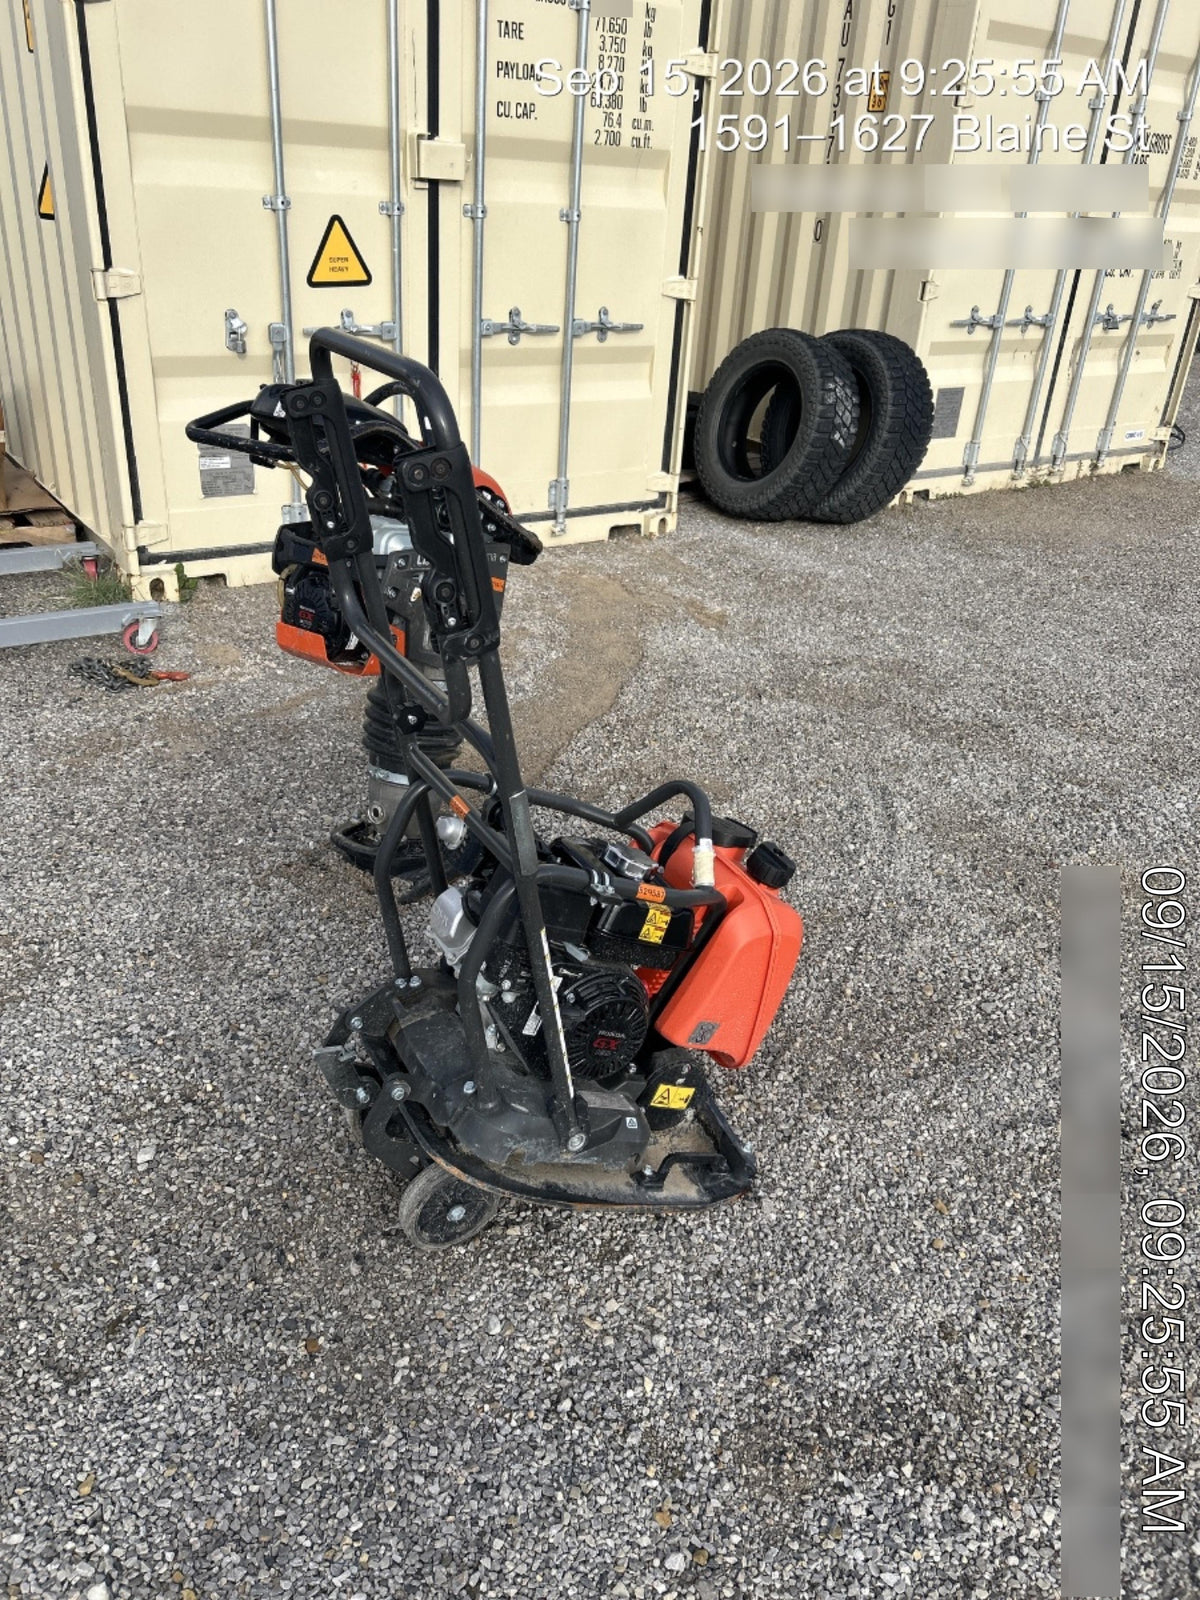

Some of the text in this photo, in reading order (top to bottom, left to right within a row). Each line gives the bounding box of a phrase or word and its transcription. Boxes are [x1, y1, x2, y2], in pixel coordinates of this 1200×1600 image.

[497, 20, 653, 60] TARE 3.750 kg
[603, 112, 622, 129] 76.4
[594, 129, 621, 147] 2.700
